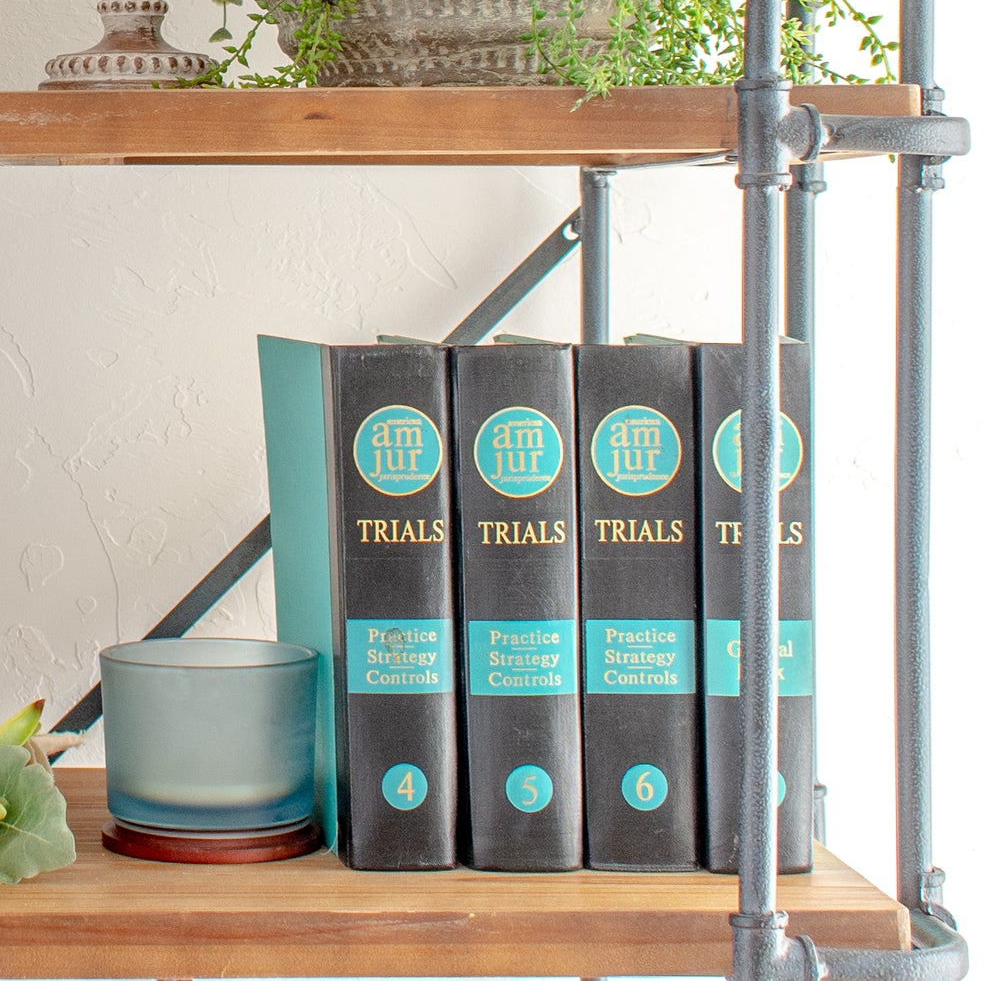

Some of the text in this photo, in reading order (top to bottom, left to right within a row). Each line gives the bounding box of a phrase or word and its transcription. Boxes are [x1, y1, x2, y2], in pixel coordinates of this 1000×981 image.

[371, 422, 423, 447] am
[492, 424, 544, 449] am
[610, 422, 661, 447] am
[369, 449, 422, 477] jur
[490, 451, 543, 479] jur
[607, 449, 660, 477] jur
[357, 519, 445, 543] TRIALS
[478, 520, 567, 545] TRIALS
[595, 519, 684, 543] TRIALS
[368, 628, 438, 643] Practice
[490, 630, 560, 645] Practice
[605, 628, 677, 644] Practice
[367, 649, 437, 666] Strategy
[489, 651, 560, 668] Strategy
[605, 649, 676, 666] Strategy
[366, 670, 439, 685] Controls
[488, 671, 562, 687] Controls
[603, 670, 678, 686] Controls
[397, 771, 415, 802] 4
[522, 775, 539, 806] 5
[636, 771, 655, 802] 6
